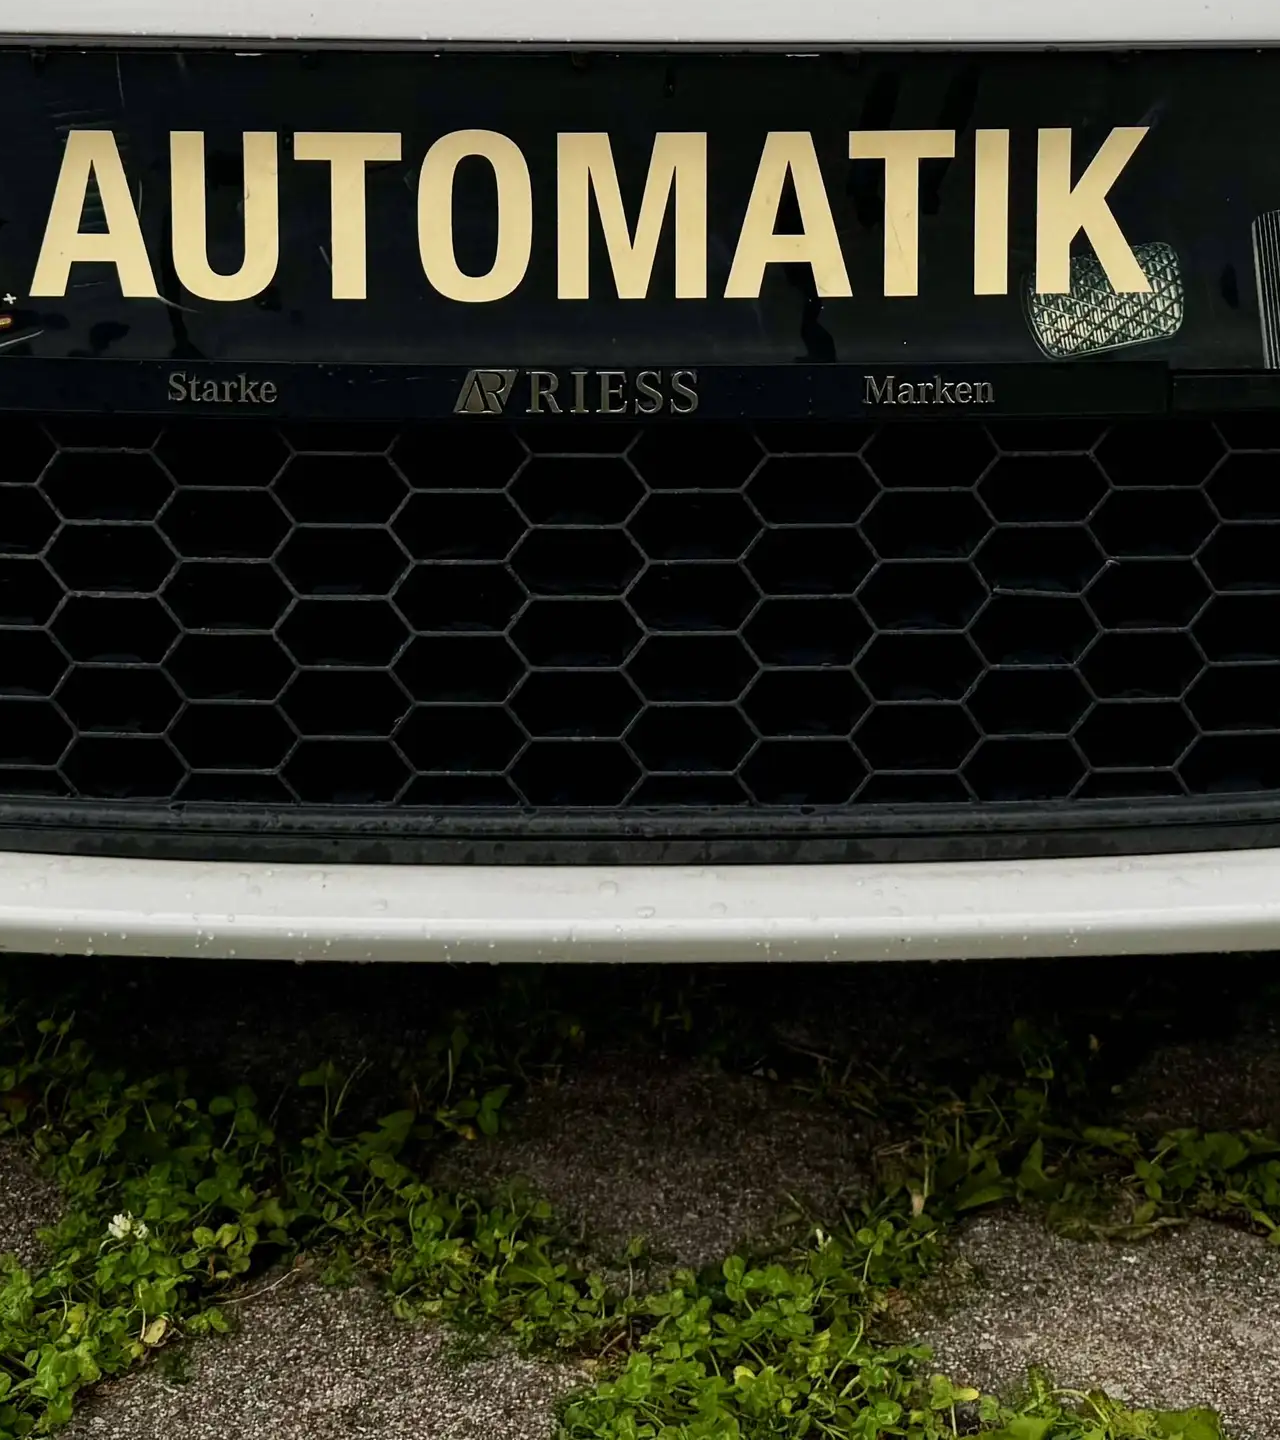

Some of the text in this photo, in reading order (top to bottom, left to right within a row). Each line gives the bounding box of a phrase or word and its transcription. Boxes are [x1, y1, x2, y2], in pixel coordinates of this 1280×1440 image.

[28, 127, 1154, 303] AUTOMATIK
[168, 371, 278, 403] Starke
[525, 369, 700, 414] RIESS
[862, 374, 995, 404] Marken
